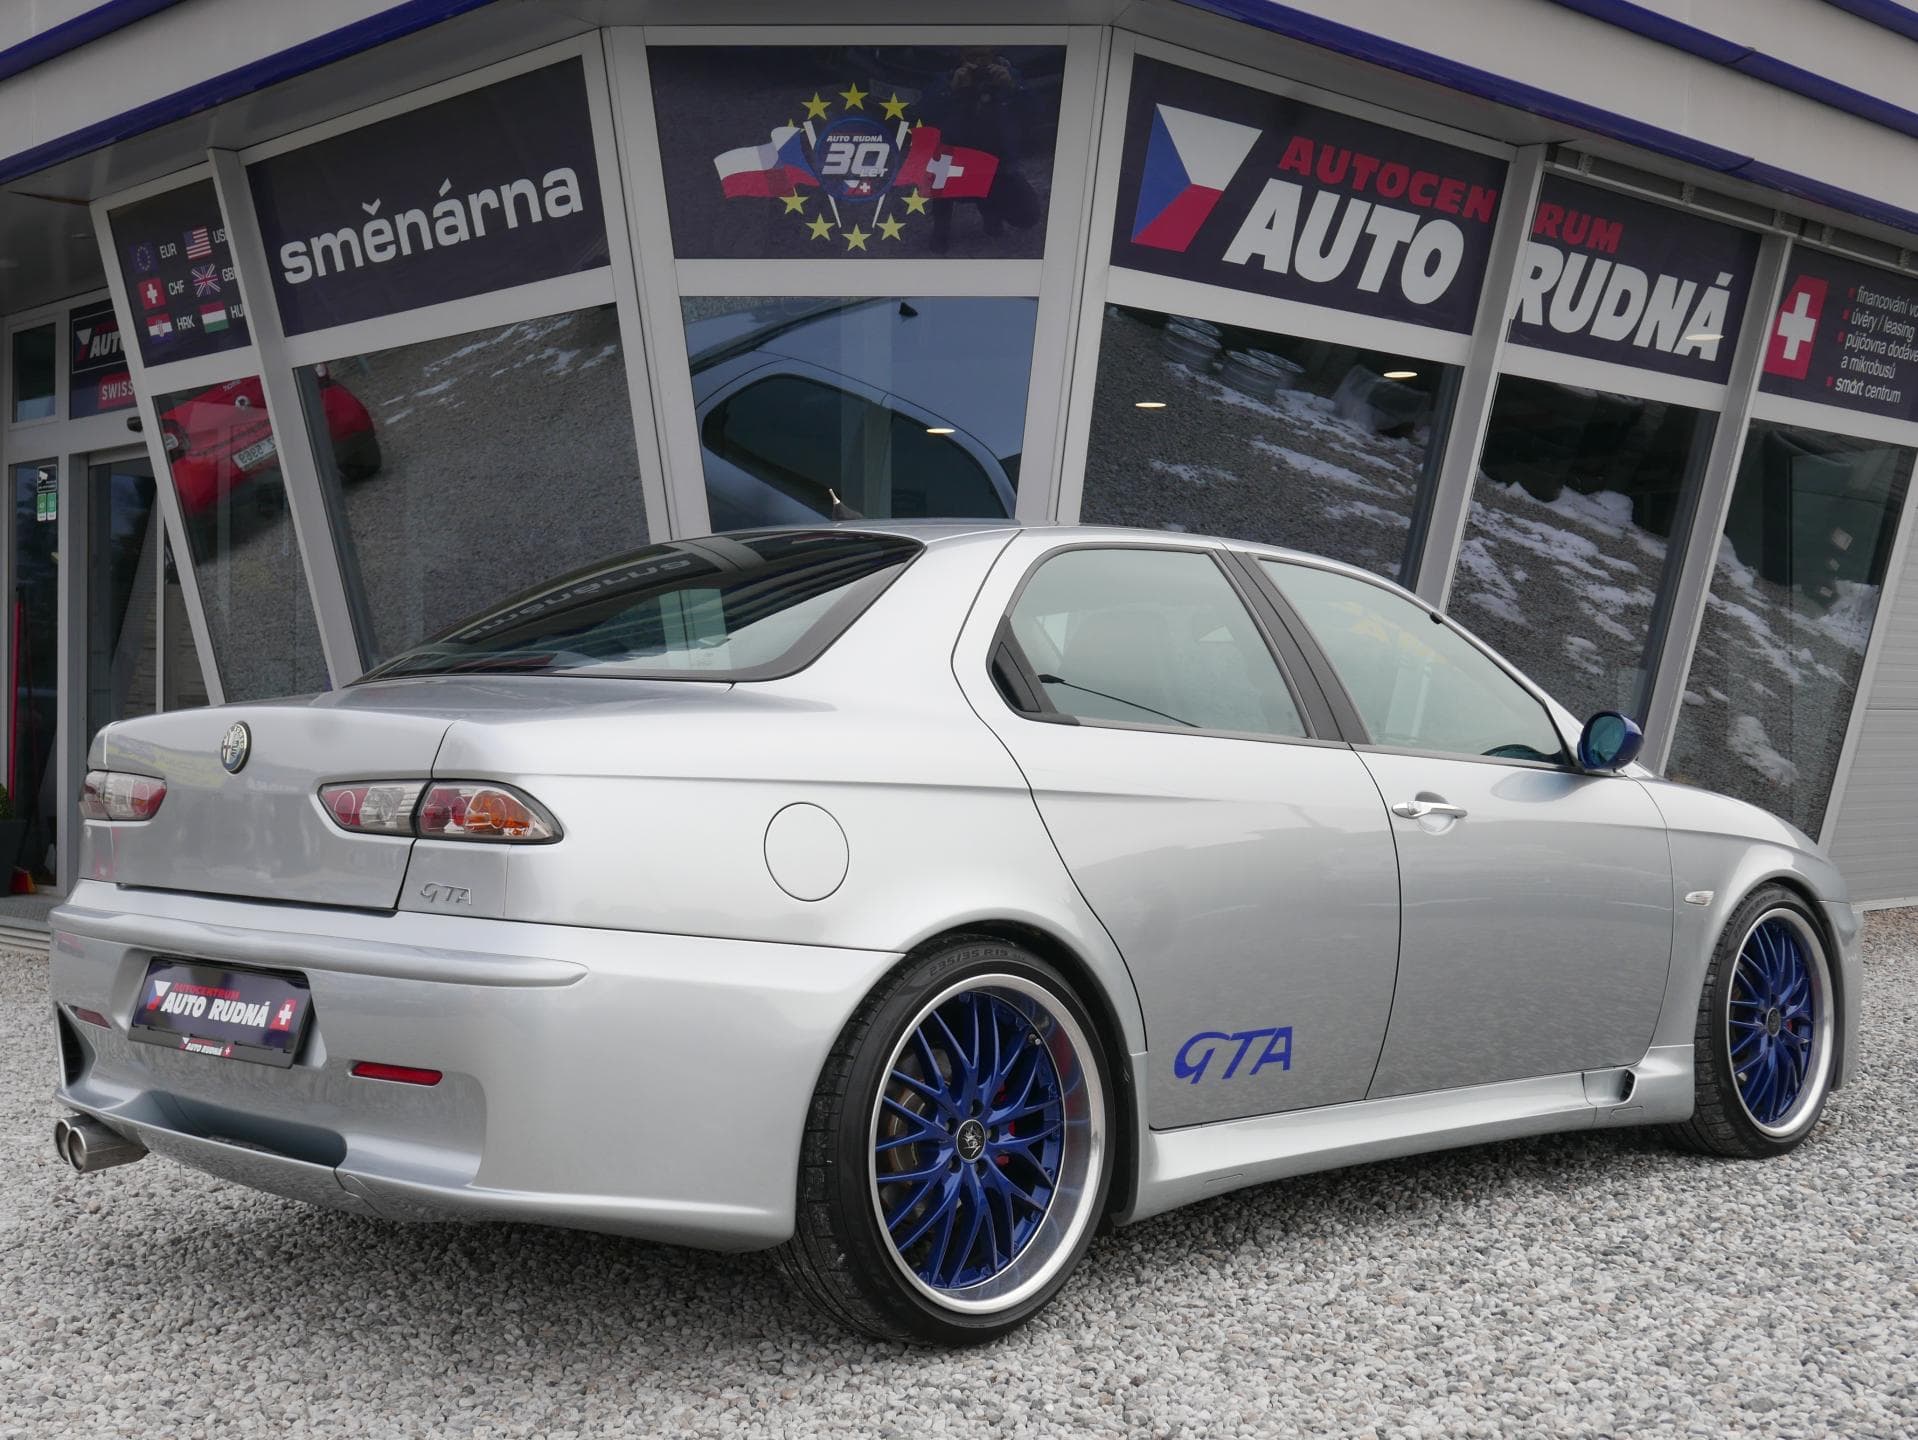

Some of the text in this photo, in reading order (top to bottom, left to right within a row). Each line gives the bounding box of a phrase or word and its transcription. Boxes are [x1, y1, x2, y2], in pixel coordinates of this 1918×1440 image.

[826, 135, 850, 143] AUTO
[821, 142, 890, 175] 30
[859, 168, 889, 177] LET
[1278, 135, 1498, 224] AUTOCEN
[213, 228, 227, 244] US
[280, 167, 584, 285] směnárna
[159, 243, 177, 259] EUR
[1222, 177, 1465, 305] AUTO
[168, 279, 185, 295] CHF
[222, 267, 237, 282] GB
[1511, 240, 1734, 362] RUDNÁ
[1856, 285, 1909, 314] financování
[176, 314, 196, 330] HRK
[1851, 307, 1878, 333] úvěry
[1883, 316, 1915, 342] leasing
[1840, 355, 1849, 369] a
[1835, 377, 1901, 403] smart centrum
[420, 881, 472, 905] GTA
[160, 992, 271, 1028] AUTO RUDNÁ
[1174, 1026, 1293, 1085] GTA
